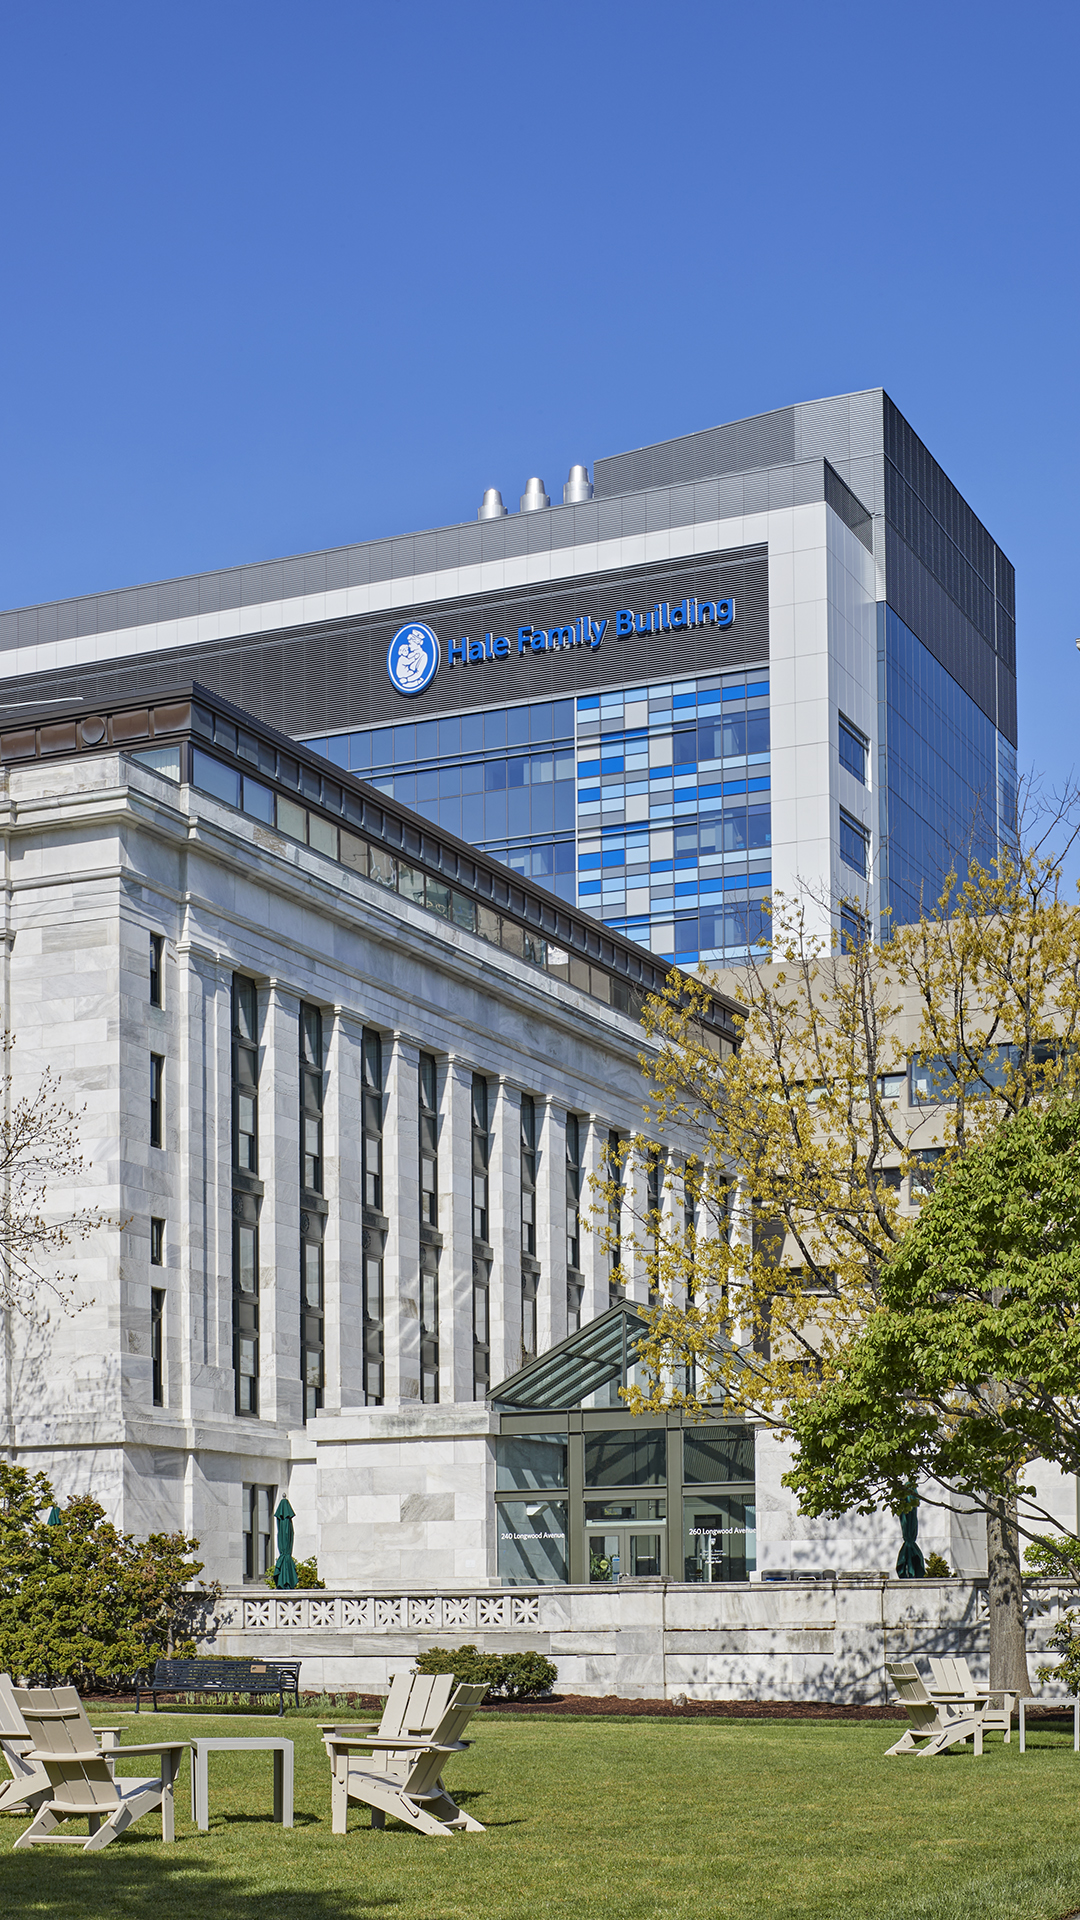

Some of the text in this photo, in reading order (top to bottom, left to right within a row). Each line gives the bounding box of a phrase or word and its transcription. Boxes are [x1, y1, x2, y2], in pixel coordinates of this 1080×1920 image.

[448, 598, 734, 665] Hale Family Building
[513, 1532, 543, 1540] Longwood
[702, 1527, 733, 1536] Longwood
